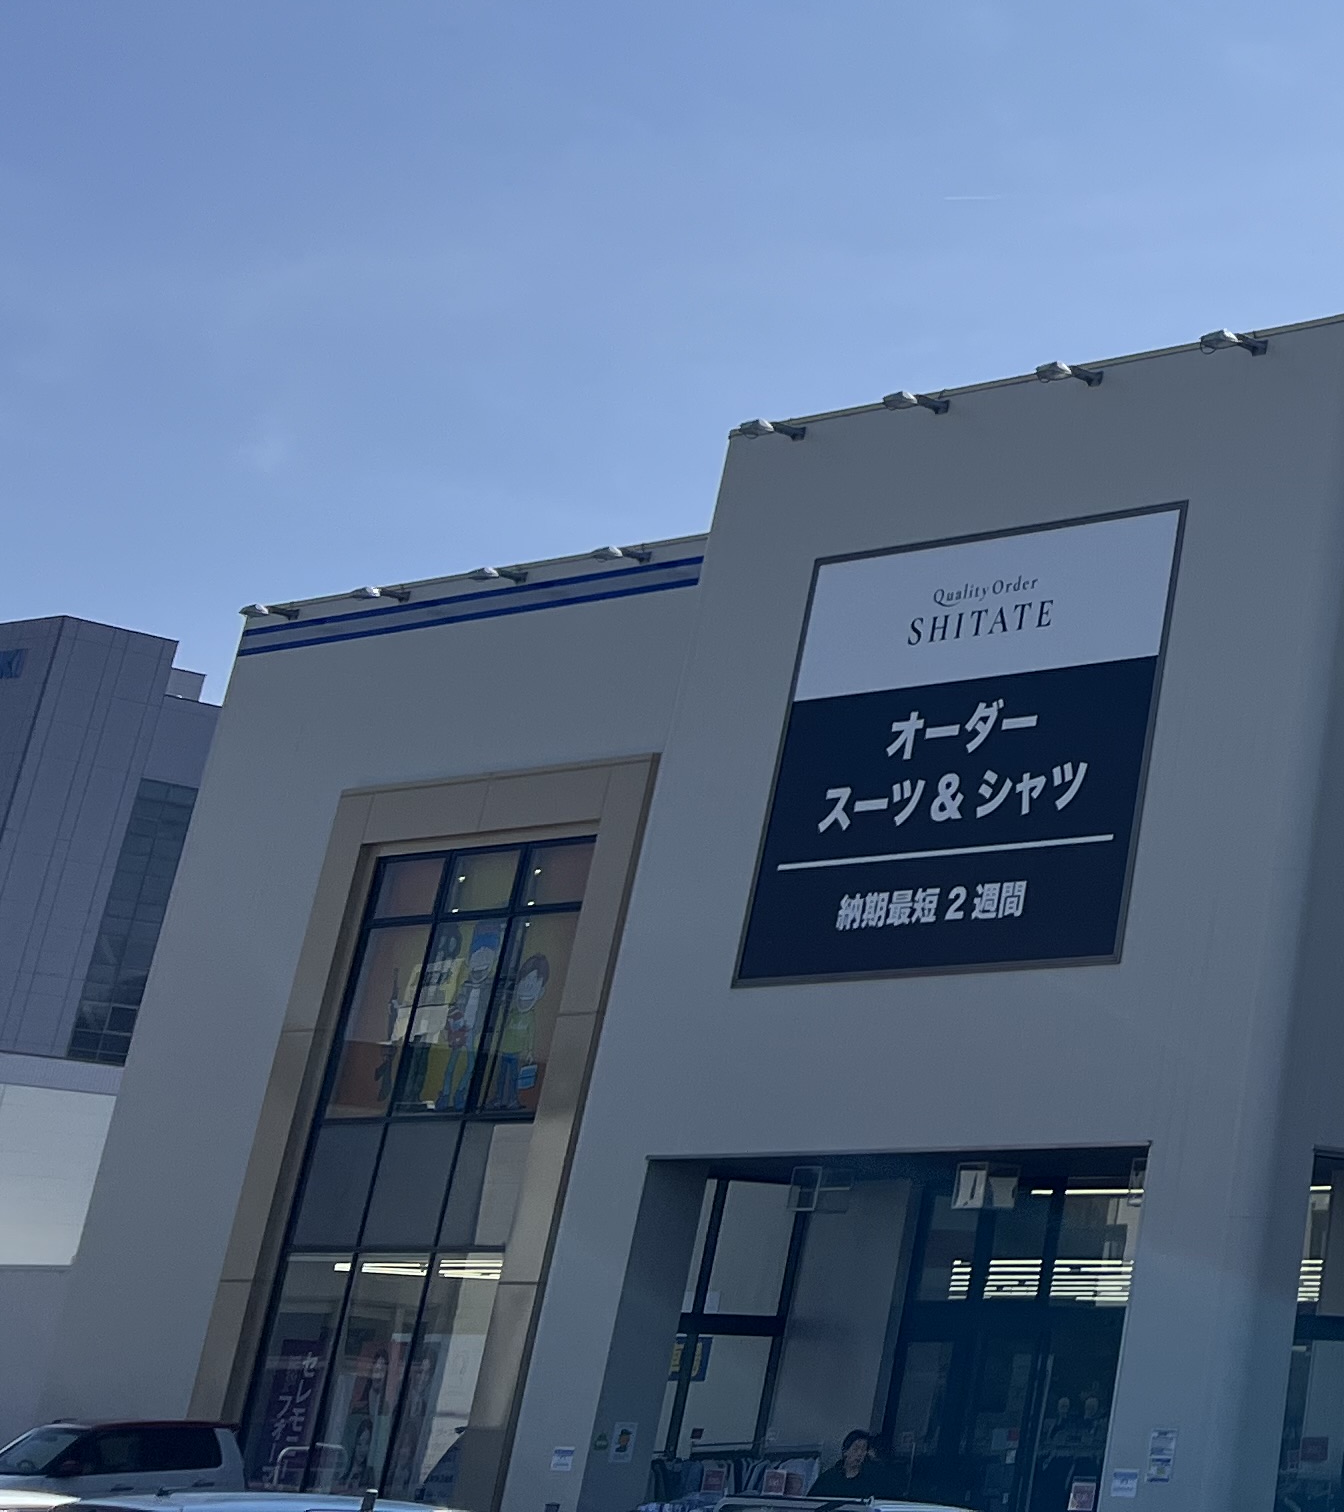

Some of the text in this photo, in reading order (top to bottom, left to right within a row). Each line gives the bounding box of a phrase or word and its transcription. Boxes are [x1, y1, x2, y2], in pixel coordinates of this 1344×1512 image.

[933, 574, 1039, 608] Quality Order
[907, 599, 1056, 647] SHITATE
[885, 699, 1039, 761] オーダー
